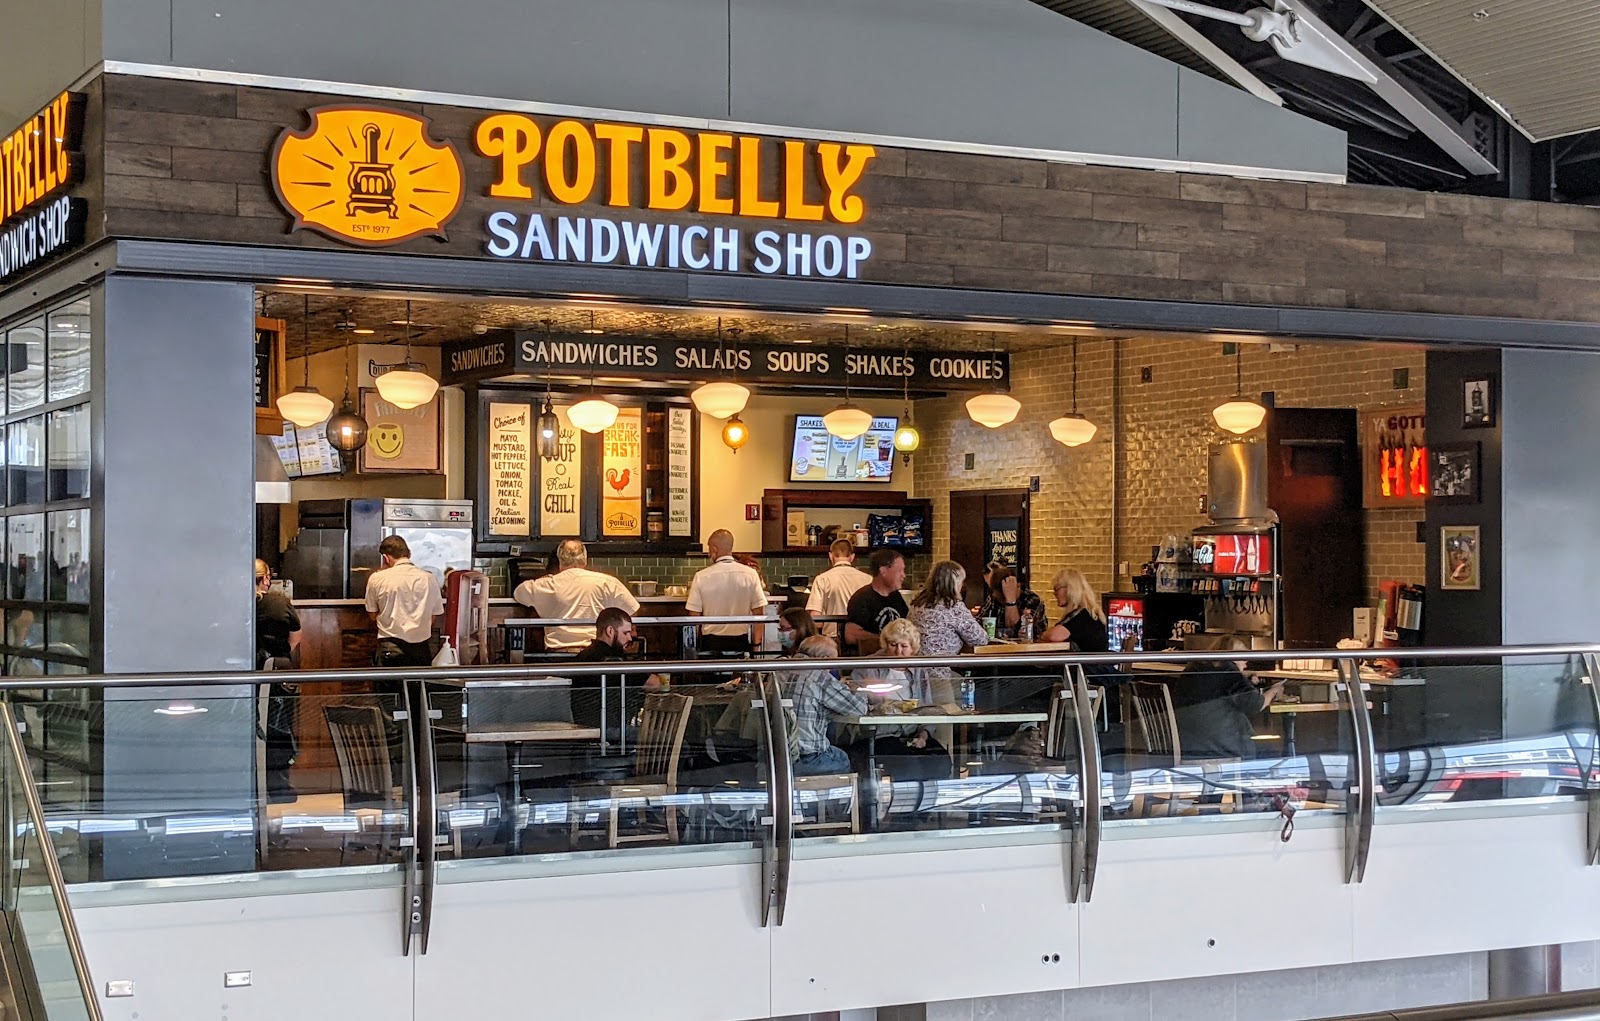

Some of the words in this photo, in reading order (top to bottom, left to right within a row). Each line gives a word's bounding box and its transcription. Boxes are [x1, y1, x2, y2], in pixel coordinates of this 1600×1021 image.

[476, 114, 876, 223] POTBELLY
[39, 195, 70, 257] SHOP
[372, 225, 391, 234] 1977
[487, 211, 739, 272] SANDWICH
[754, 230, 872, 279] SHOP
[451, 342, 505, 372] SANDWICHES
[521, 340, 658, 367] SANDWICHES
[675, 347, 752, 371] SALADS
[767, 351, 830, 373] SOUPS
[845, 354, 915, 377] SHAKES
[929, 358, 1004, 380] COOKIES
[493, 416, 516, 429] Choice
[517, 411, 526, 426] of
[800, 419, 823, 427] SHAKES
[616, 422, 625, 430] US
[625, 422, 638, 430] FOR
[1373, 418, 1386, 433] YA
[500, 434, 519, 443] MAYO,
[604, 429, 640, 442] BREAK-
[493, 443, 527, 453] MUSTARD,
[604, 442, 640, 458] FAST!
[491, 452, 502, 460] HOT
[503, 452, 528, 462] PEPPERS,
[494, 461, 526, 471] LETTUCE,
[500, 471, 523, 480] ONION,
[496, 480, 524, 489] TOMATO,
[545, 477, 575, 491] Real
[498, 489, 522, 499] PICKLE,
[499, 498, 510, 507] OIL
[511, 499, 518, 507] &
[544, 493, 576, 514] CHILI
[495, 507, 521, 516] Italian
[490, 516, 526, 525] SEASONING
[608, 519, 634, 527] POTBELLY
[990, 530, 1017, 543] THANKS
[1001, 544, 1017, 557] your
